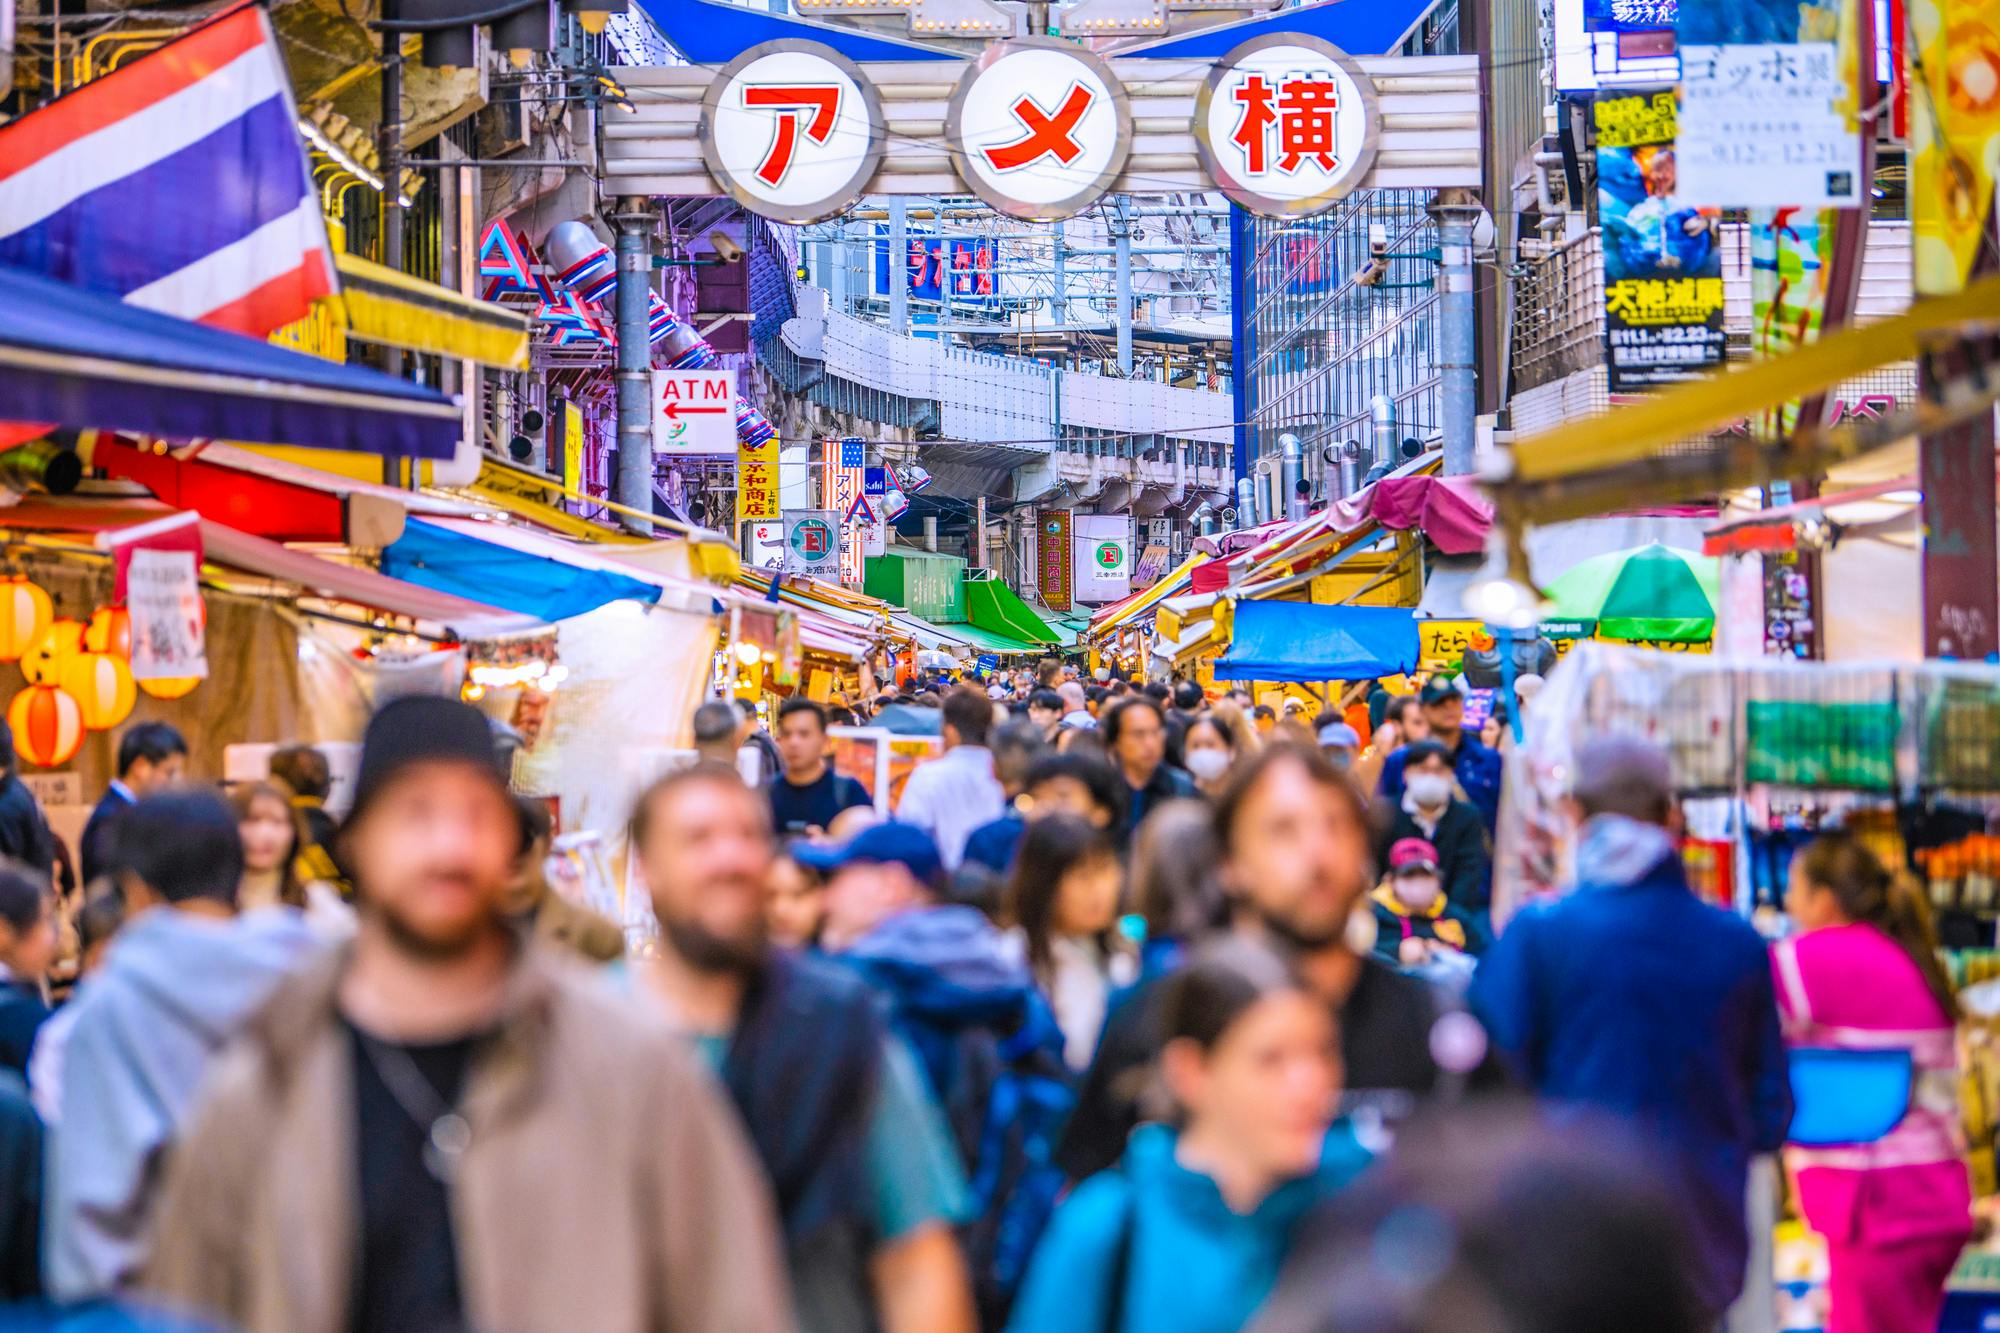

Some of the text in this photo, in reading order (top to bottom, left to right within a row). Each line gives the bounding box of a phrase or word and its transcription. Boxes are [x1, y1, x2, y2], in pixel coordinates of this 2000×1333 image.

[741, 71, 1341, 188] アメ横
[662, 379, 727, 400] ATM
[743, 459, 767, 516] 京和商店
[864, 481, 883, 491] sahi
[768, 490, 776, 515] 上野店
[1047, 537, 1060, 592] 中田商店
[1431, 630, 1475, 653] たら
